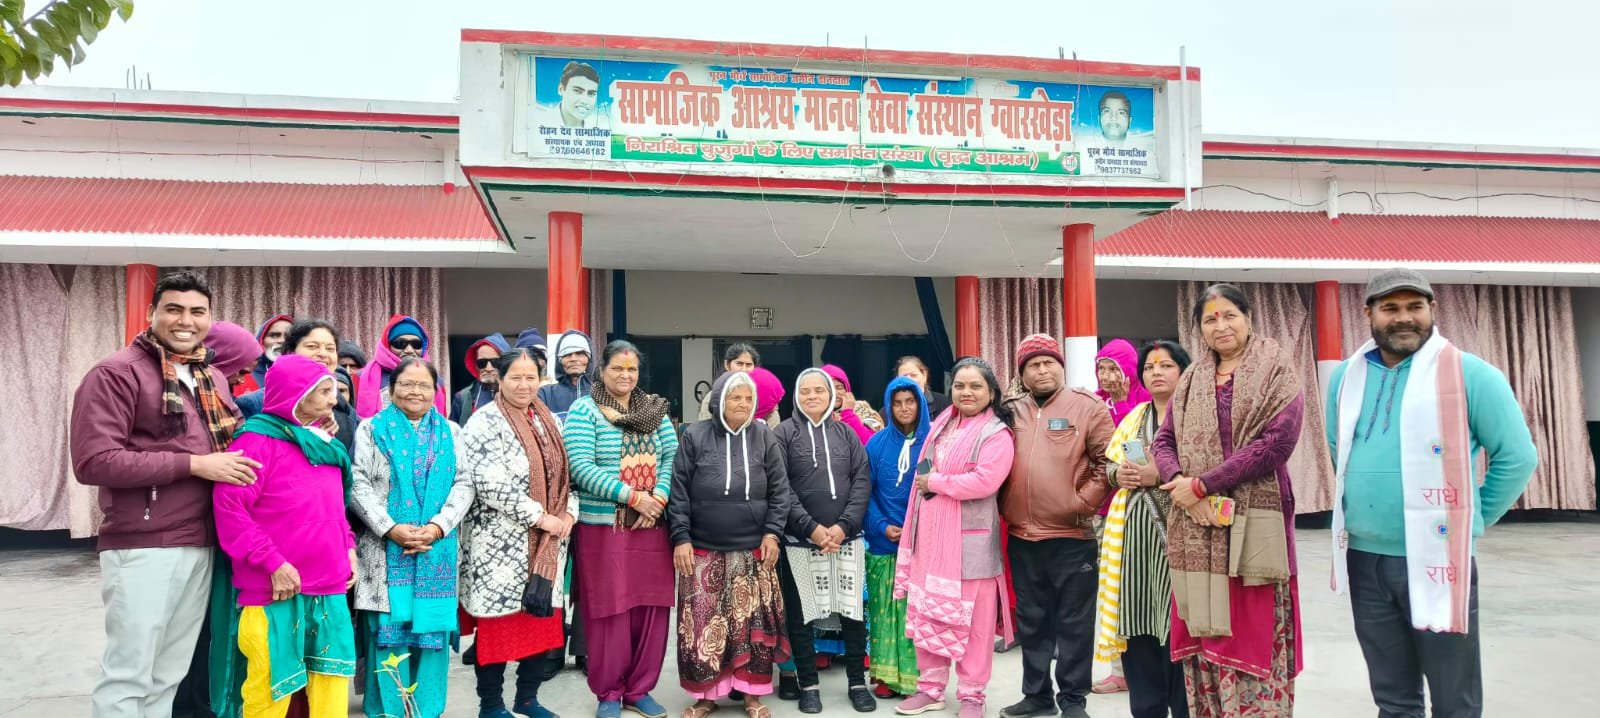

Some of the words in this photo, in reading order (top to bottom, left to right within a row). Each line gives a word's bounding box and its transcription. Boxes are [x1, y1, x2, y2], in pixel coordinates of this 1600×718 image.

[616, 71, 722, 127] सामाजिक
[731, 86, 797, 130] आश्रय
[801, 90, 861, 132] मानव
[866, 79, 909, 135] सेवा
[915, 82, 984, 138] संस्थान
[990, 89, 1074, 152] ग्वारखेड़ा
[538, 125, 558, 135] रोहन
[560, 125, 571, 136] देव
[575, 127, 612, 138] सामाजिक
[626, 137, 697, 154] निराश्रित
[758, 142, 777, 156] के
[781, 142, 814, 158] लिए
[818, 144, 877, 161] समर्पित
[880, 146, 924, 162] संस्था
[929, 146, 971, 166] (वृद्ध
[976, 150, 1039, 170] आश्रम)
[1087, 147, 1100, 158] पूरन
[1118, 147, 1148, 158] सामाजिक
[1423, 481, 1459, 506] राधे
[1426, 560, 1457, 585] राधे
